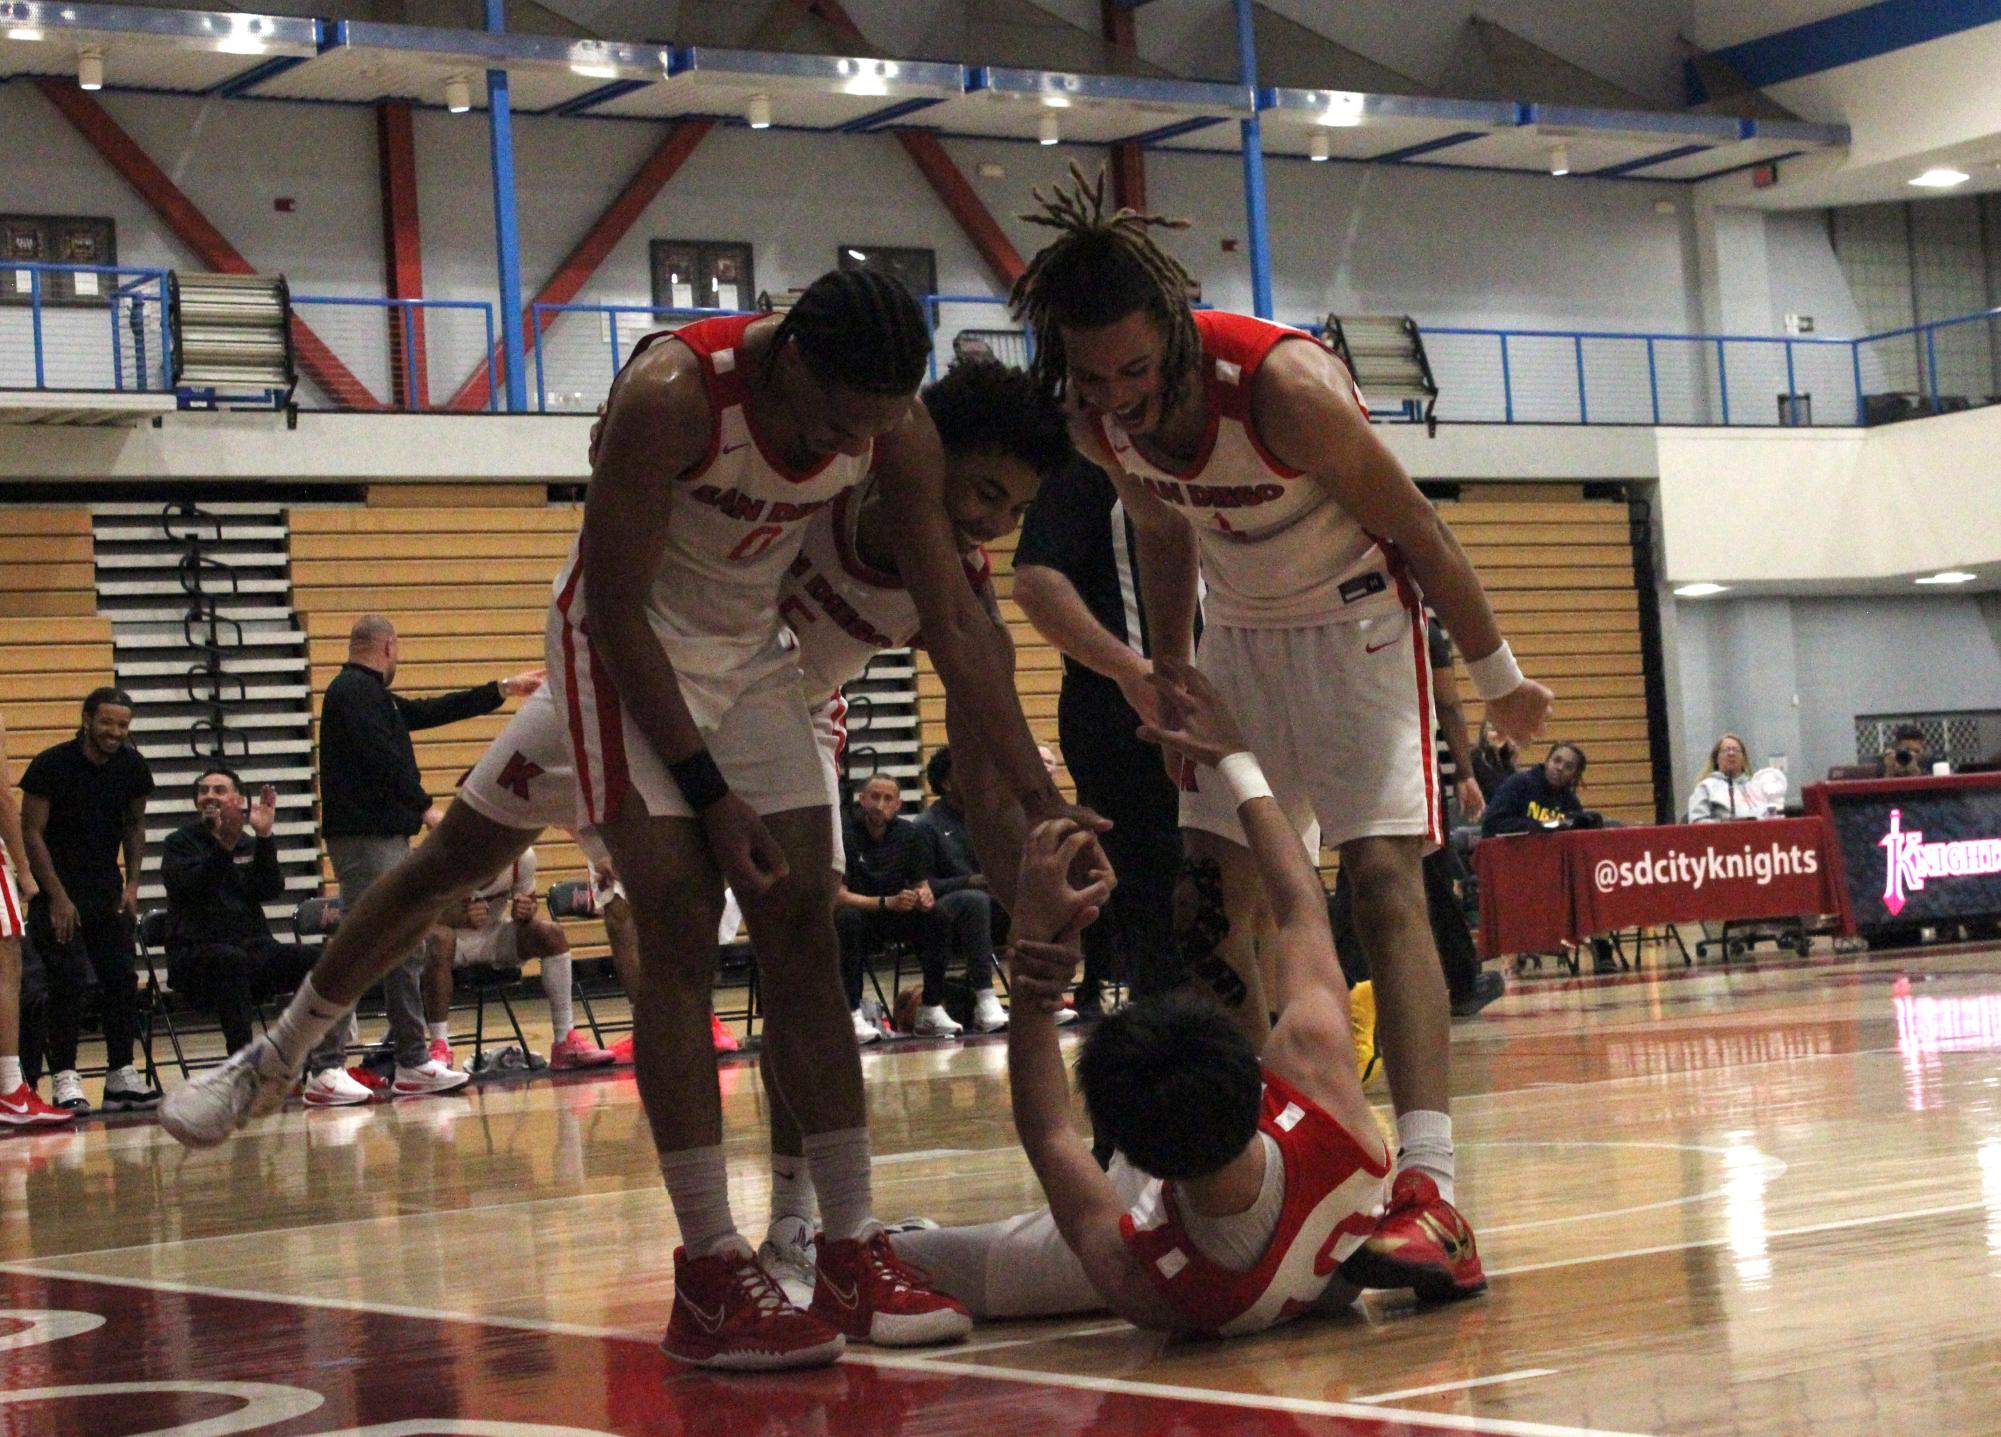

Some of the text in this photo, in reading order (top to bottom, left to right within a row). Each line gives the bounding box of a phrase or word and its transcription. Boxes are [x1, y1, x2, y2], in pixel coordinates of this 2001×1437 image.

[496, 750, 546, 801] K
[1595, 842, 1819, 893] @sdcityknights
[1878, 810, 2001, 915] KNIGHT
